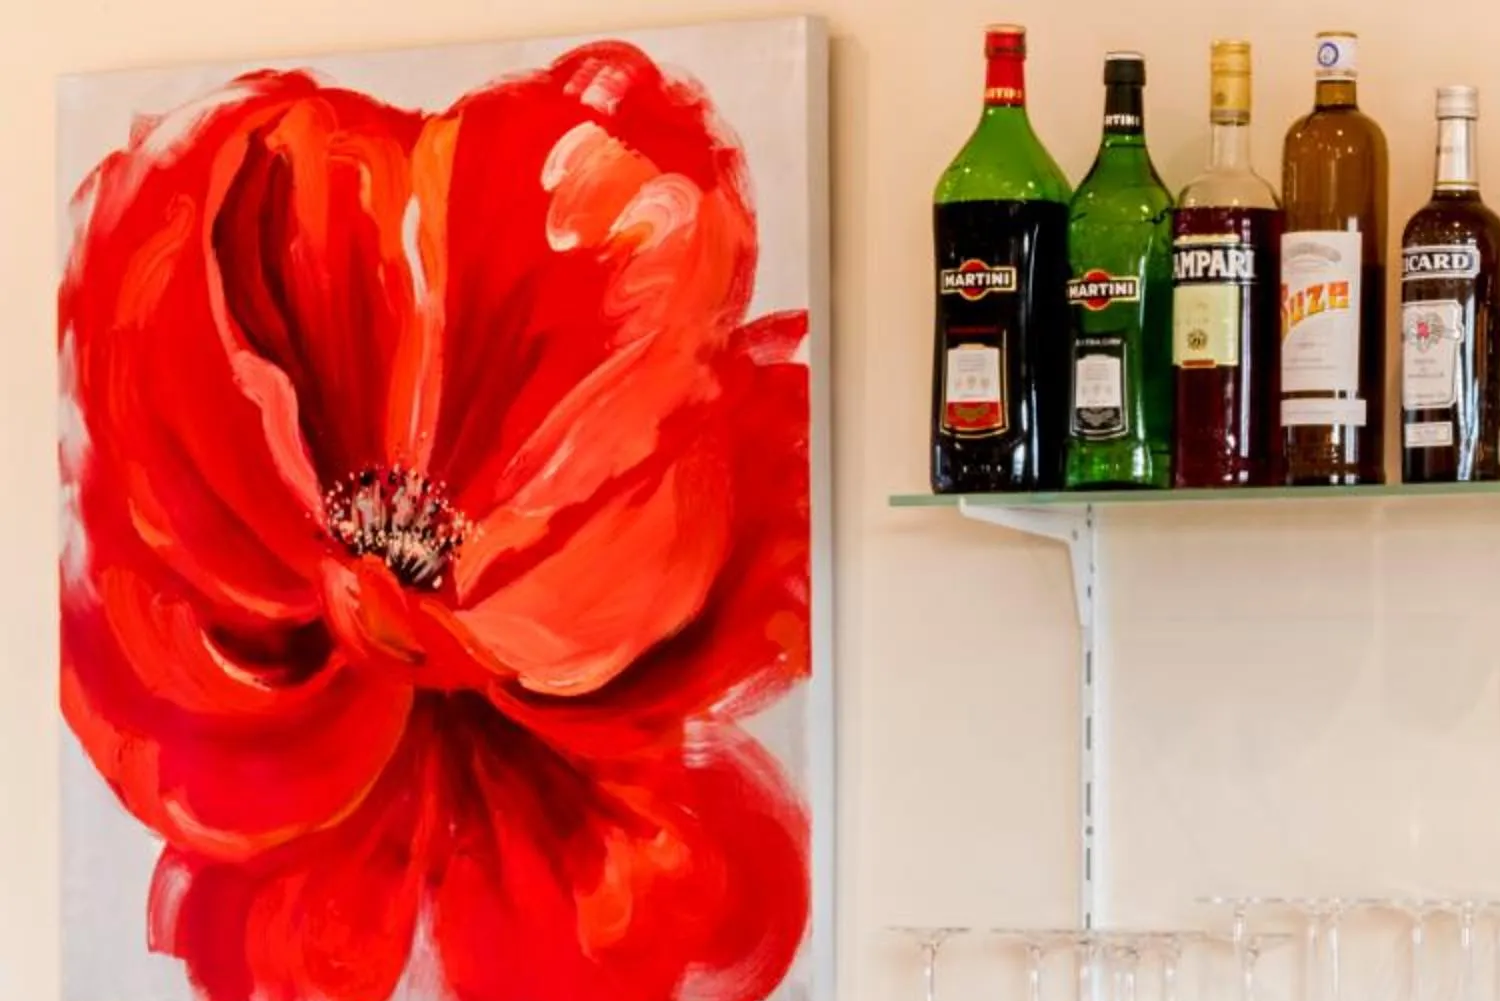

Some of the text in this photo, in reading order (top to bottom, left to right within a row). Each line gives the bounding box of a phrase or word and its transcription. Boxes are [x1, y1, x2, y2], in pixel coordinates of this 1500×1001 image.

[1172, 250, 1256, 278] AMPARI
[944, 273, 1010, 288] MARTINI
[1069, 282, 1134, 298] MARTINI
